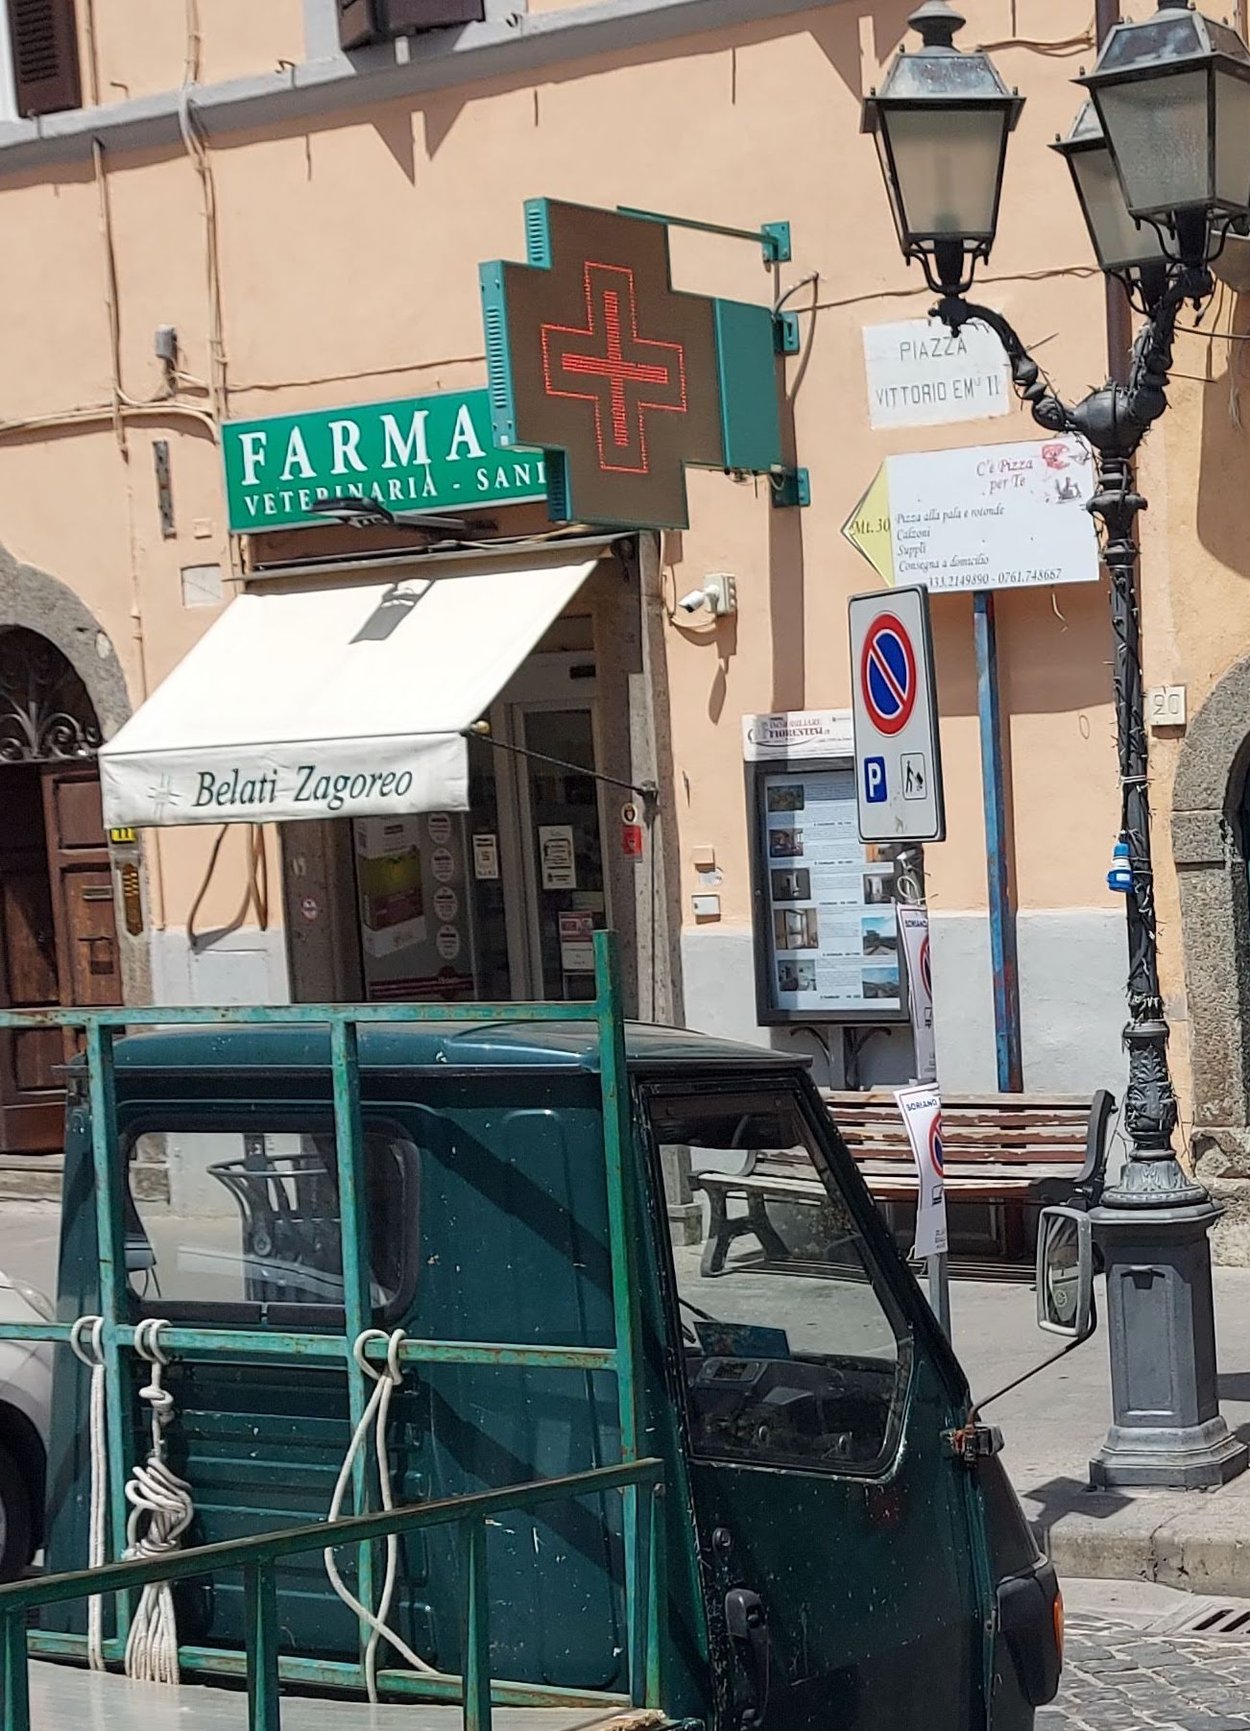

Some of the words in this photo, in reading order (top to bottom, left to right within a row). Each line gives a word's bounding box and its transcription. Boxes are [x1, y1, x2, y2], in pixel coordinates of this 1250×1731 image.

[899, 337, 968, 362] PIAZZA
[875, 382, 947, 406] VITTORIO
[238, 403, 488, 487] FARMA
[191, 767, 279, 808] Belati
[292, 764, 414, 811] Zagoreo
[867, 762, 881, 798] P
